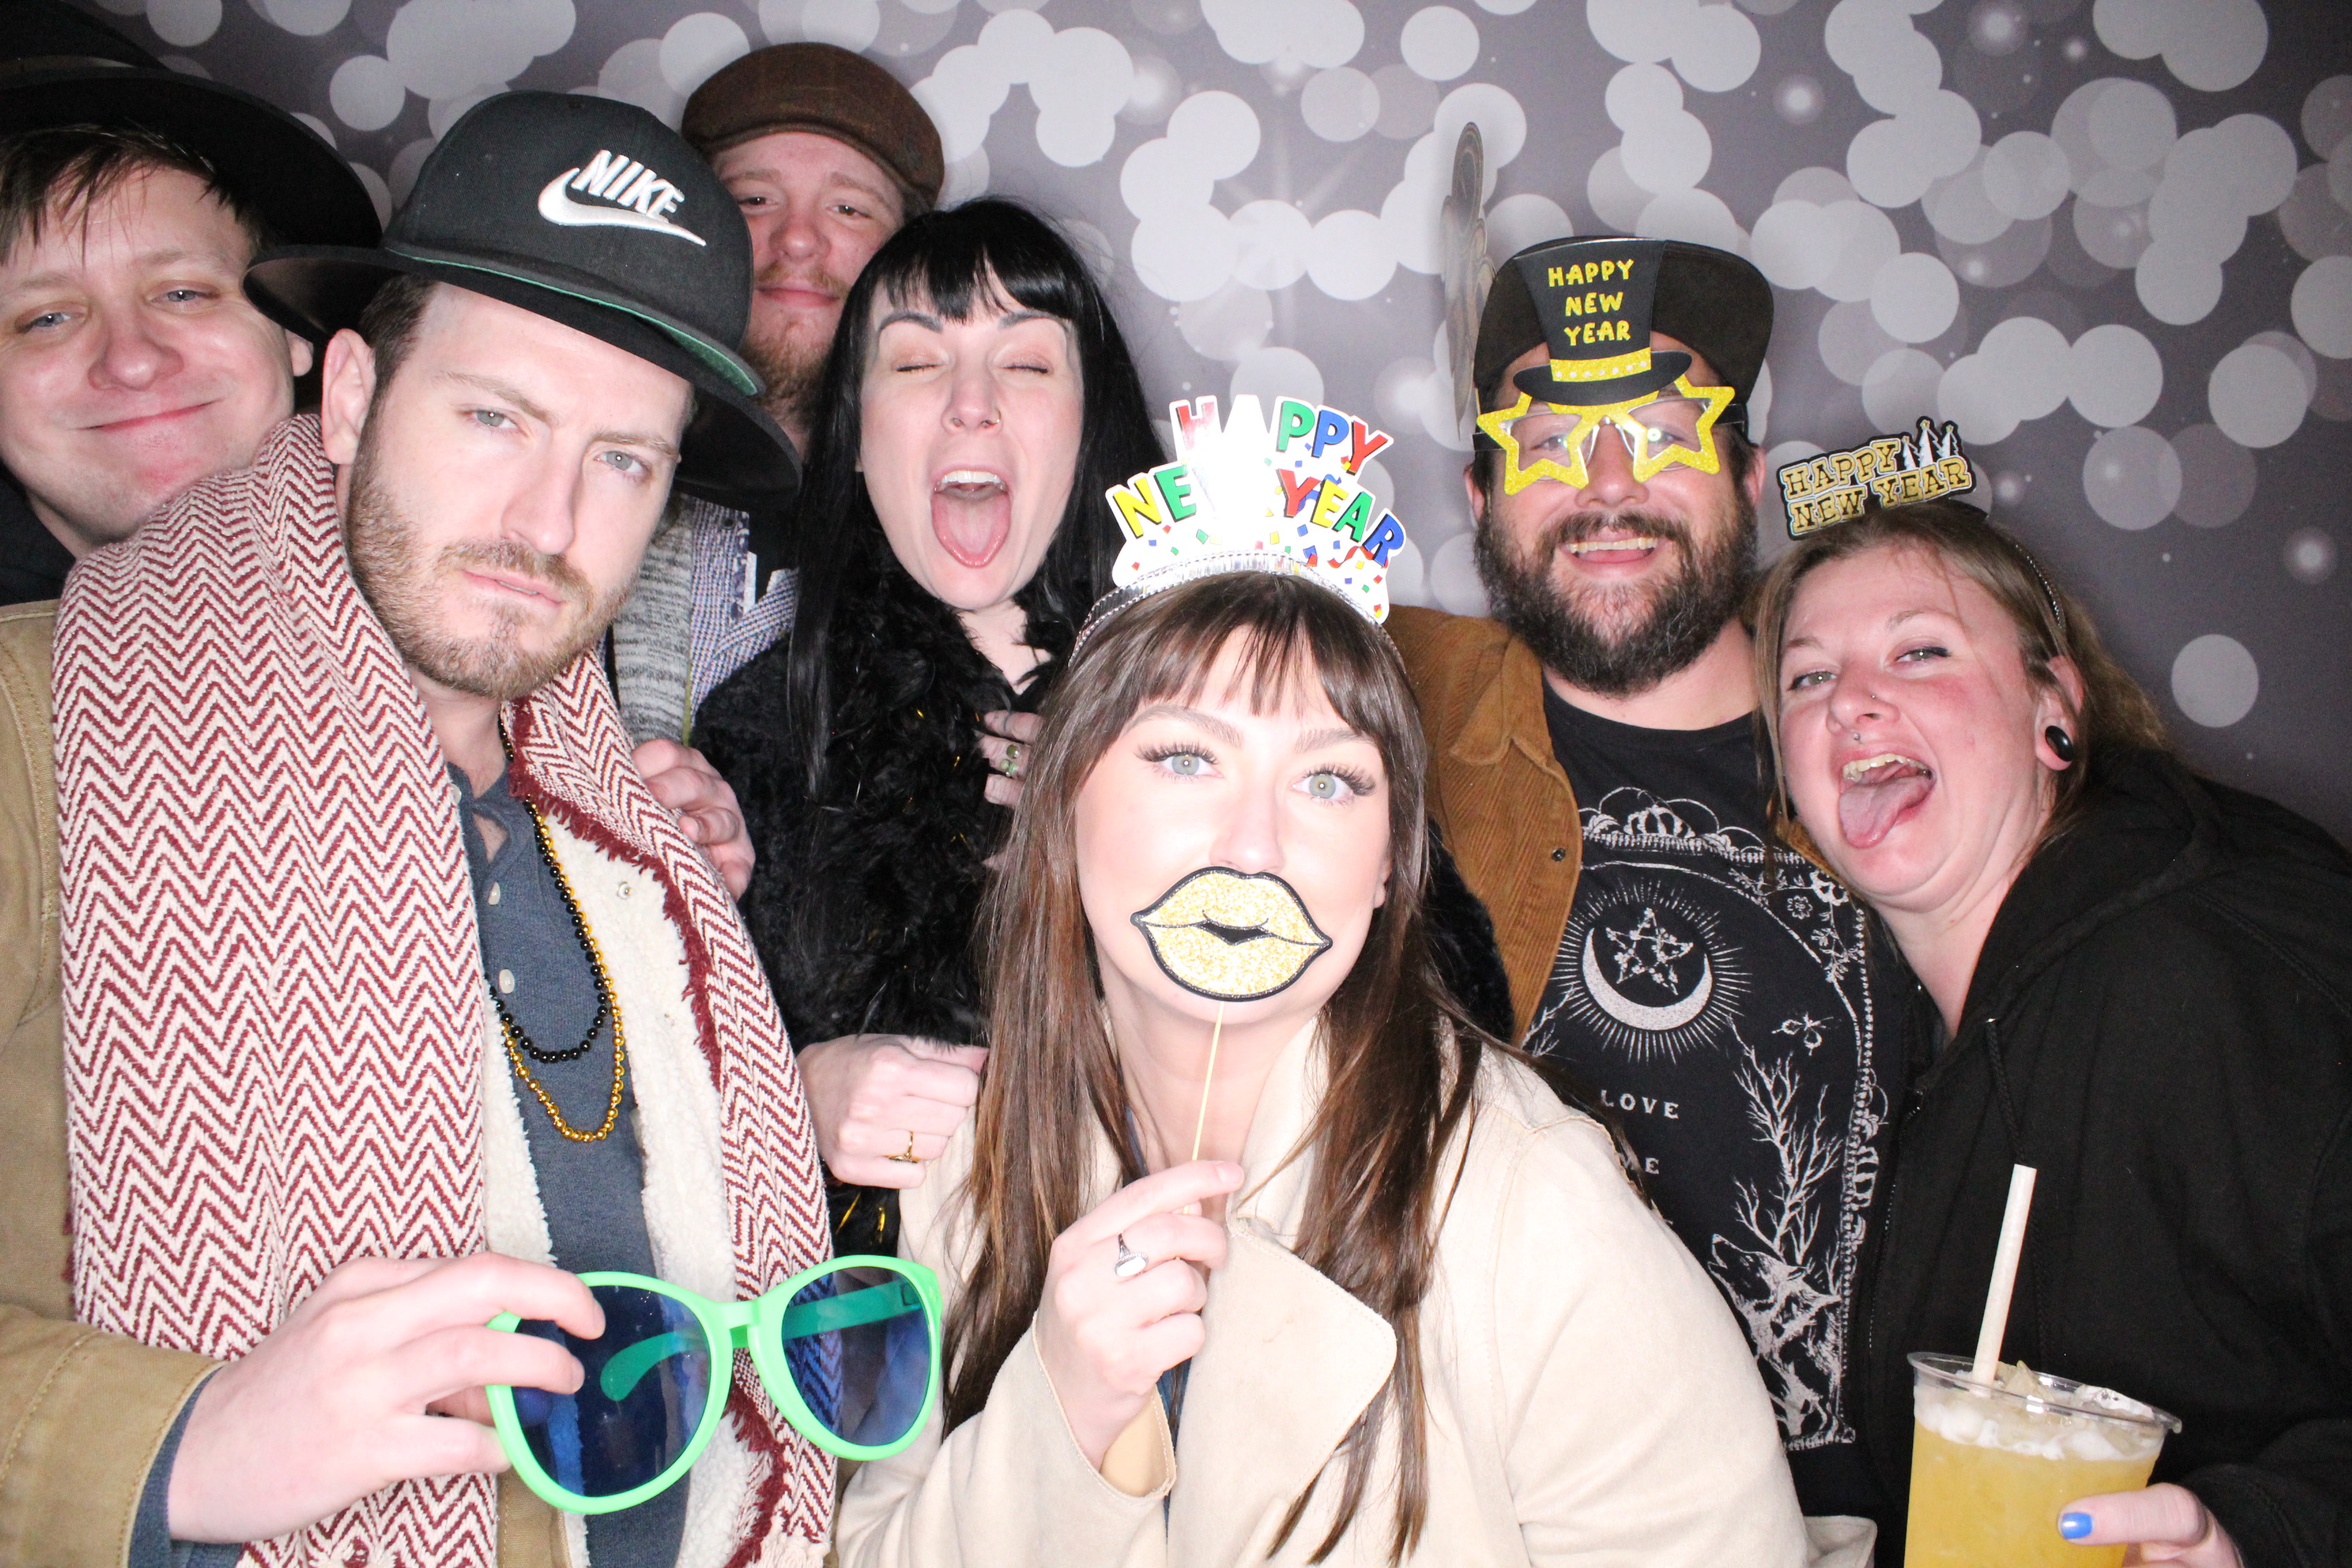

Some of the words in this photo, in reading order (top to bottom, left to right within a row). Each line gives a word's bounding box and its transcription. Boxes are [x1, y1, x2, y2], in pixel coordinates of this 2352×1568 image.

[570, 149, 685, 224] NIKE
[1548, 259, 1635, 287] HAPPY
[1565, 291, 1624, 316] NEW
[1564, 320, 1631, 346] YEAR
[1176, 399, 1389, 476] HPPY
[1782, 441, 1897, 497] HAPPY
[1791, 488, 1865, 531] NEW
[1874, 459, 1969, 505] YEAR
[1113, 465, 1218, 538] NE
[1277, 468, 1405, 567] YEAR
[1601, 1090, 1679, 1120] LOVE
